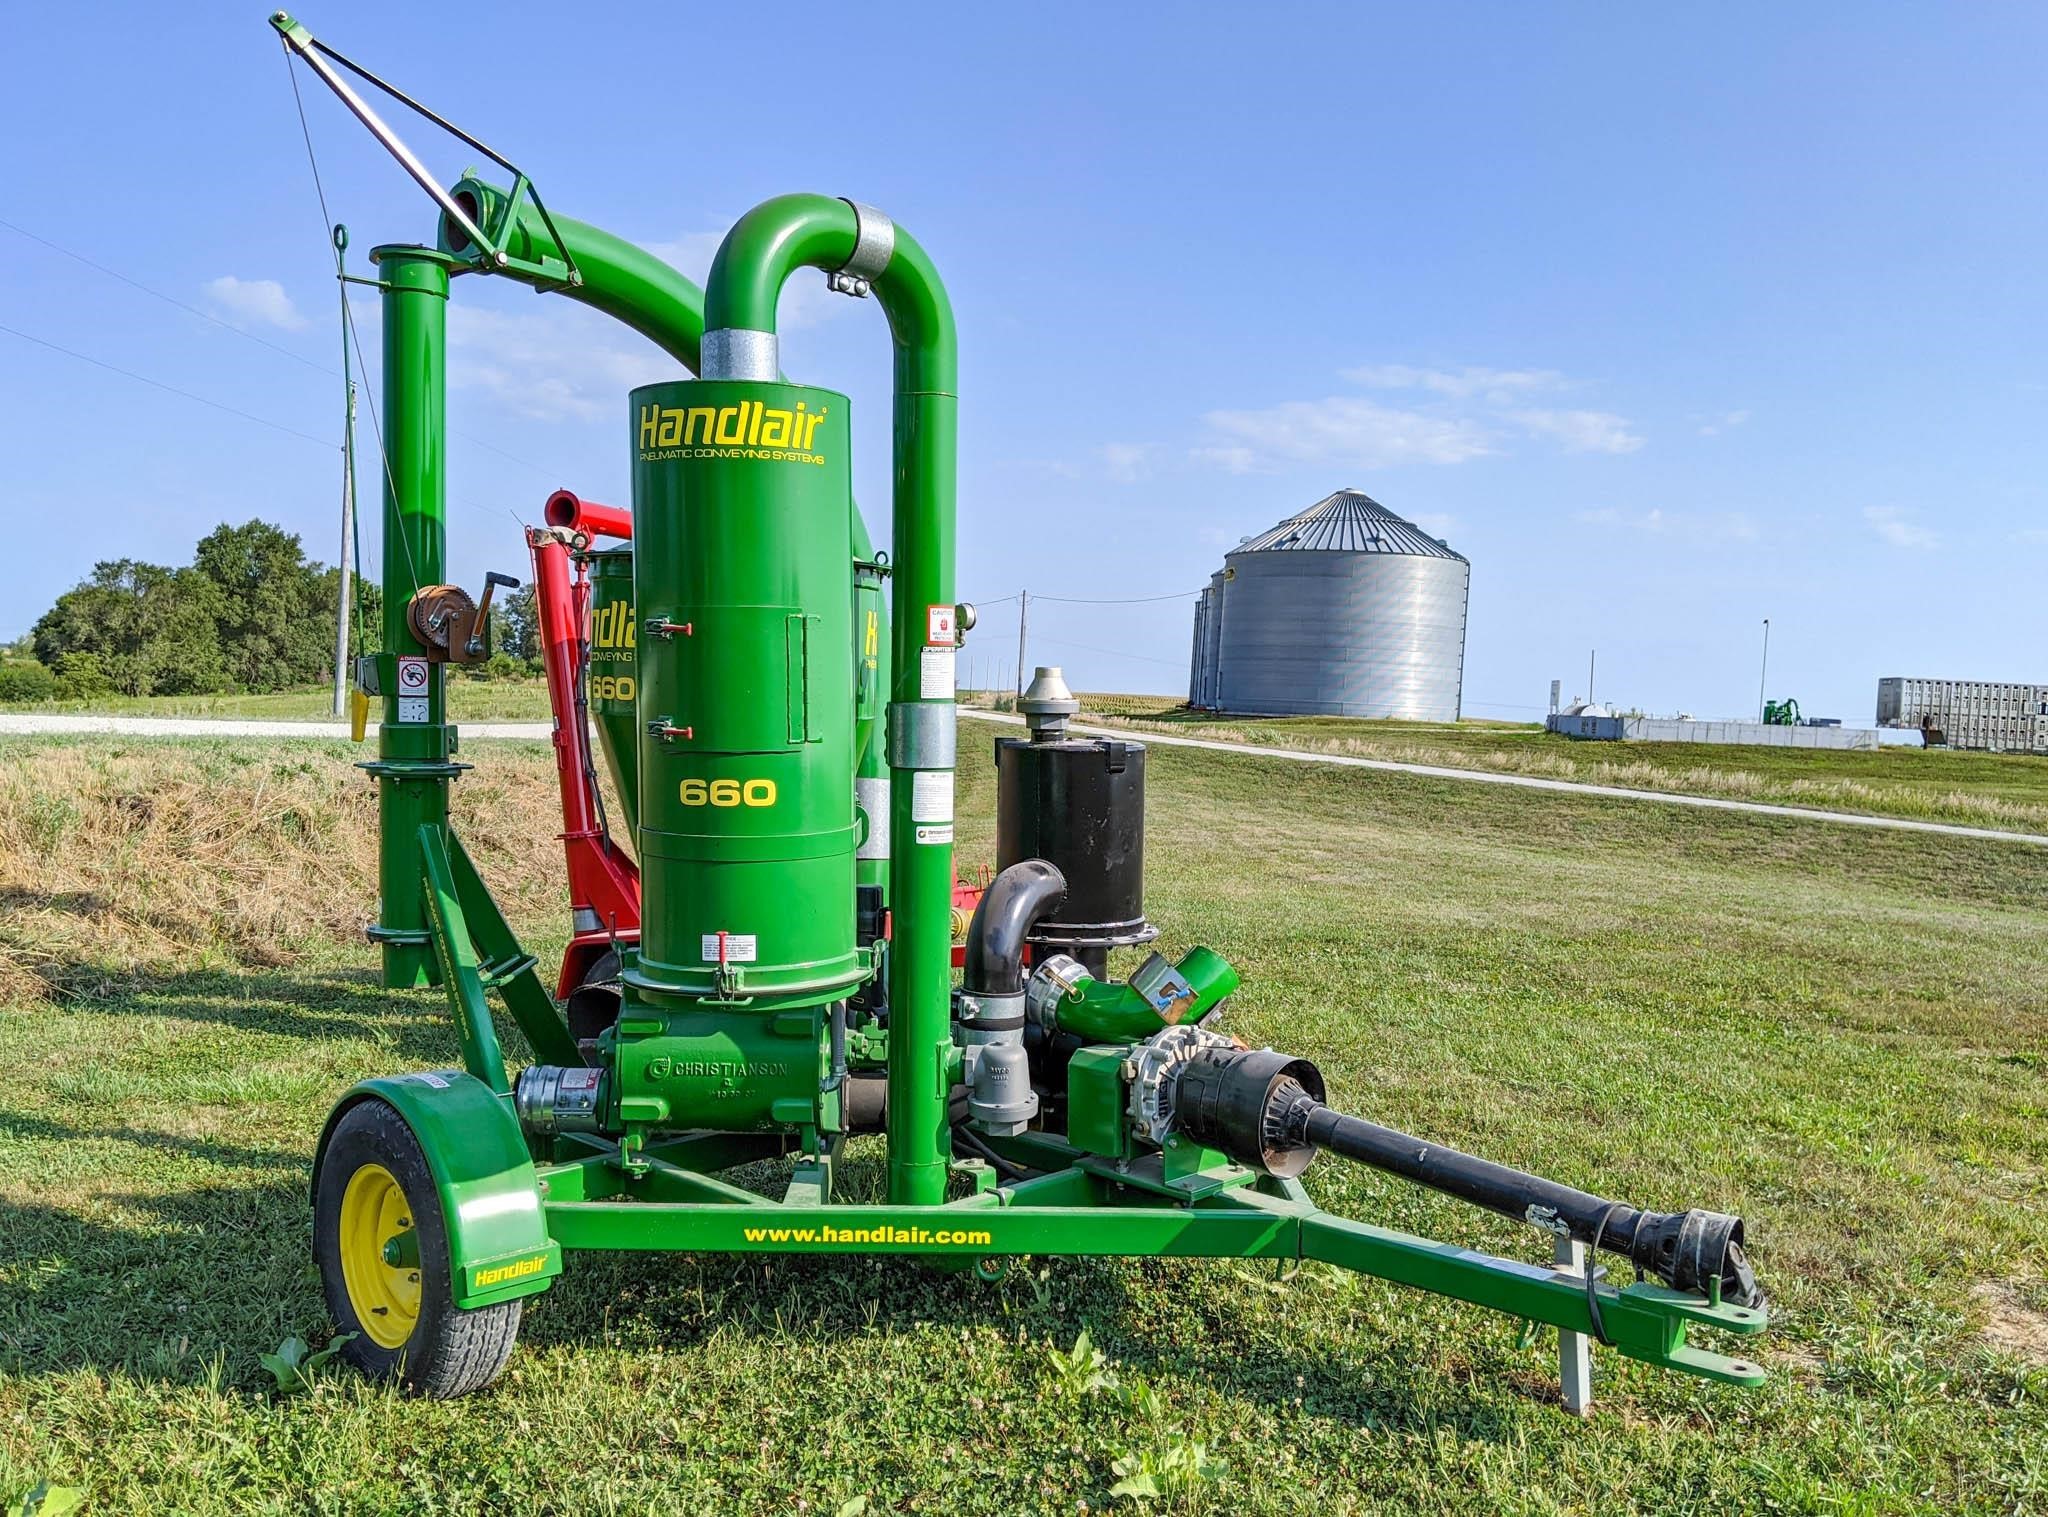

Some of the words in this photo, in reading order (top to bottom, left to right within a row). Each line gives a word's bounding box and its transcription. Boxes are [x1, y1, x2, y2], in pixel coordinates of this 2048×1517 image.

[639, 400, 825, 450] Handlair
[639, 449, 692, 461] PNEUMATIC
[694, 448, 771, 459] CONVEYING
[772, 451, 825, 465] SYSTEMS
[592, 651, 633, 662] ONVEYING
[592, 675, 636, 701] 660
[679, 778, 777, 807] 660
[675, 1061, 788, 1077] CHRISTIANSON
[743, 1225, 992, 1245] www.handlair.com
[475, 1256, 547, 1288] Handlair
